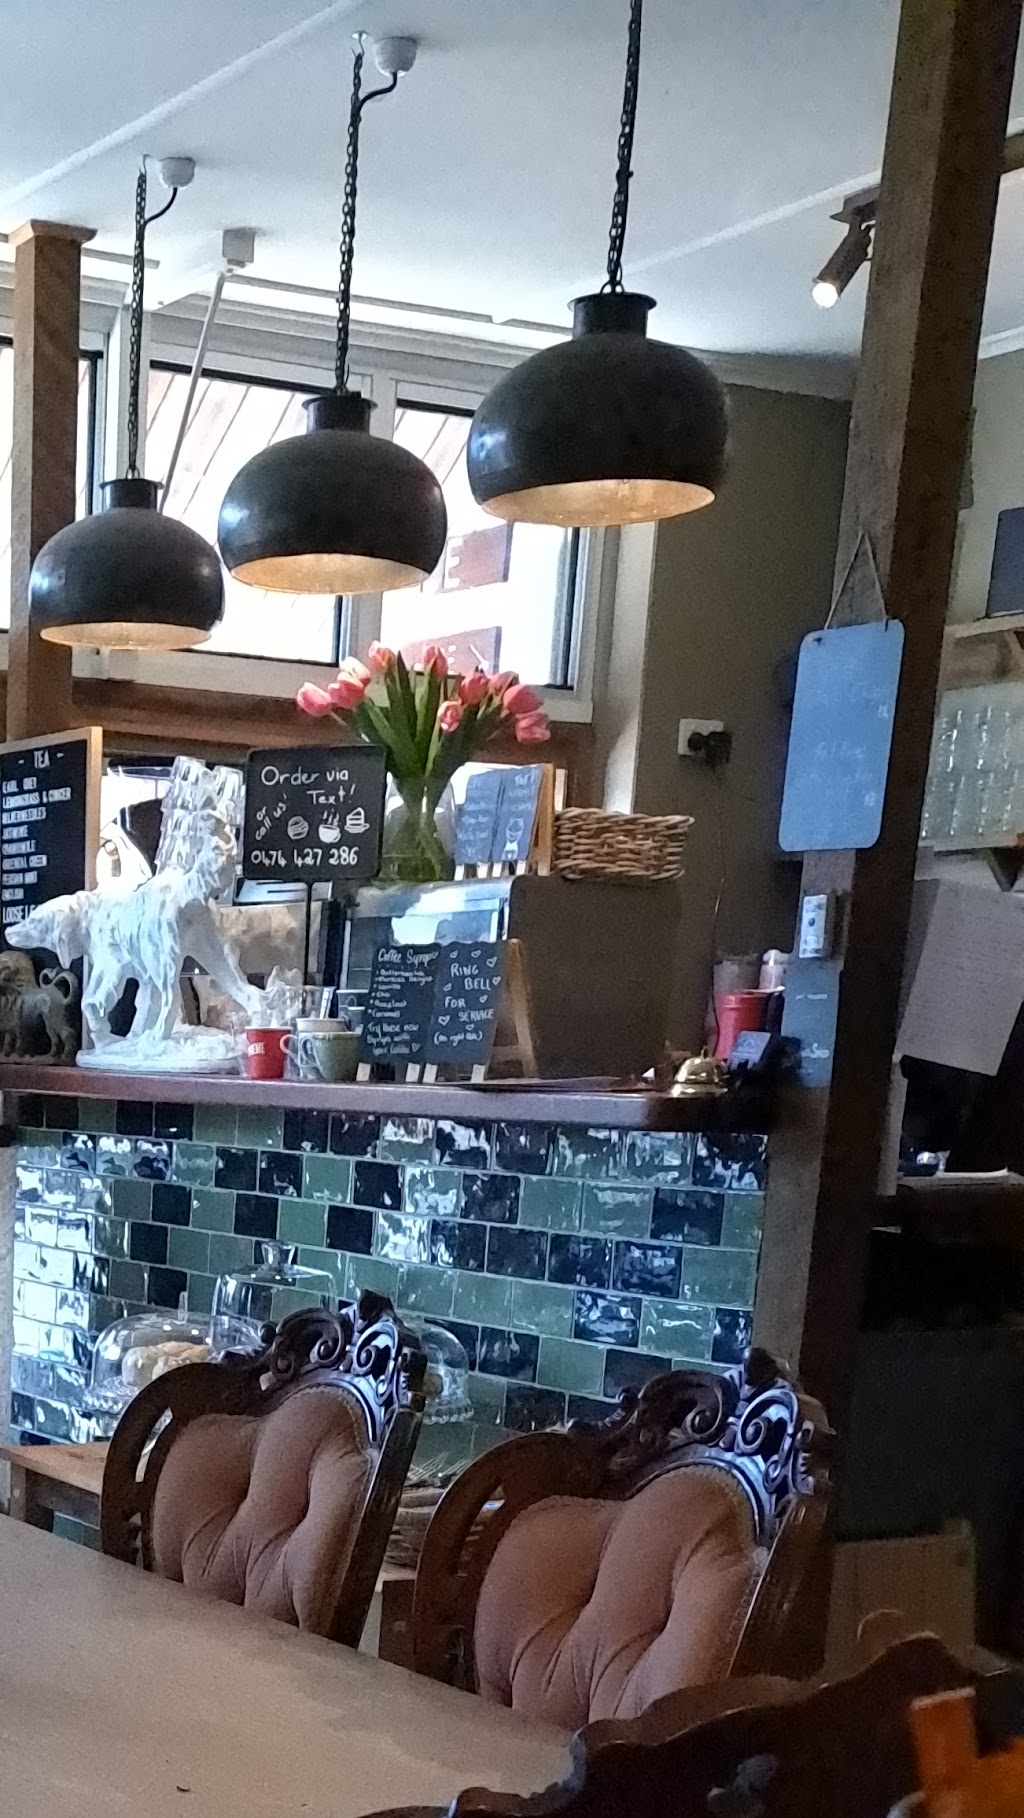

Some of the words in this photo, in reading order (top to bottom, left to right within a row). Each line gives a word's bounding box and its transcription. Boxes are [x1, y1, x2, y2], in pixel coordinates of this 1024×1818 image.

[33, 749, 50, 769] TEA
[261, 766, 320, 785] Order
[326, 769, 349, 781] via
[306, 784, 356, 804] Text!
[256, 806, 267, 821] or
[255, 816, 273, 840] call
[251, 850, 287, 867] 0474
[294, 849, 323, 867] 427
[328, 846, 360, 865] 286
[450, 962, 479, 978] RING
[464, 976, 491, 991] BELL
[445, 995, 466, 1008] FOR
[458, 1008, 495, 1022] SERVICE
